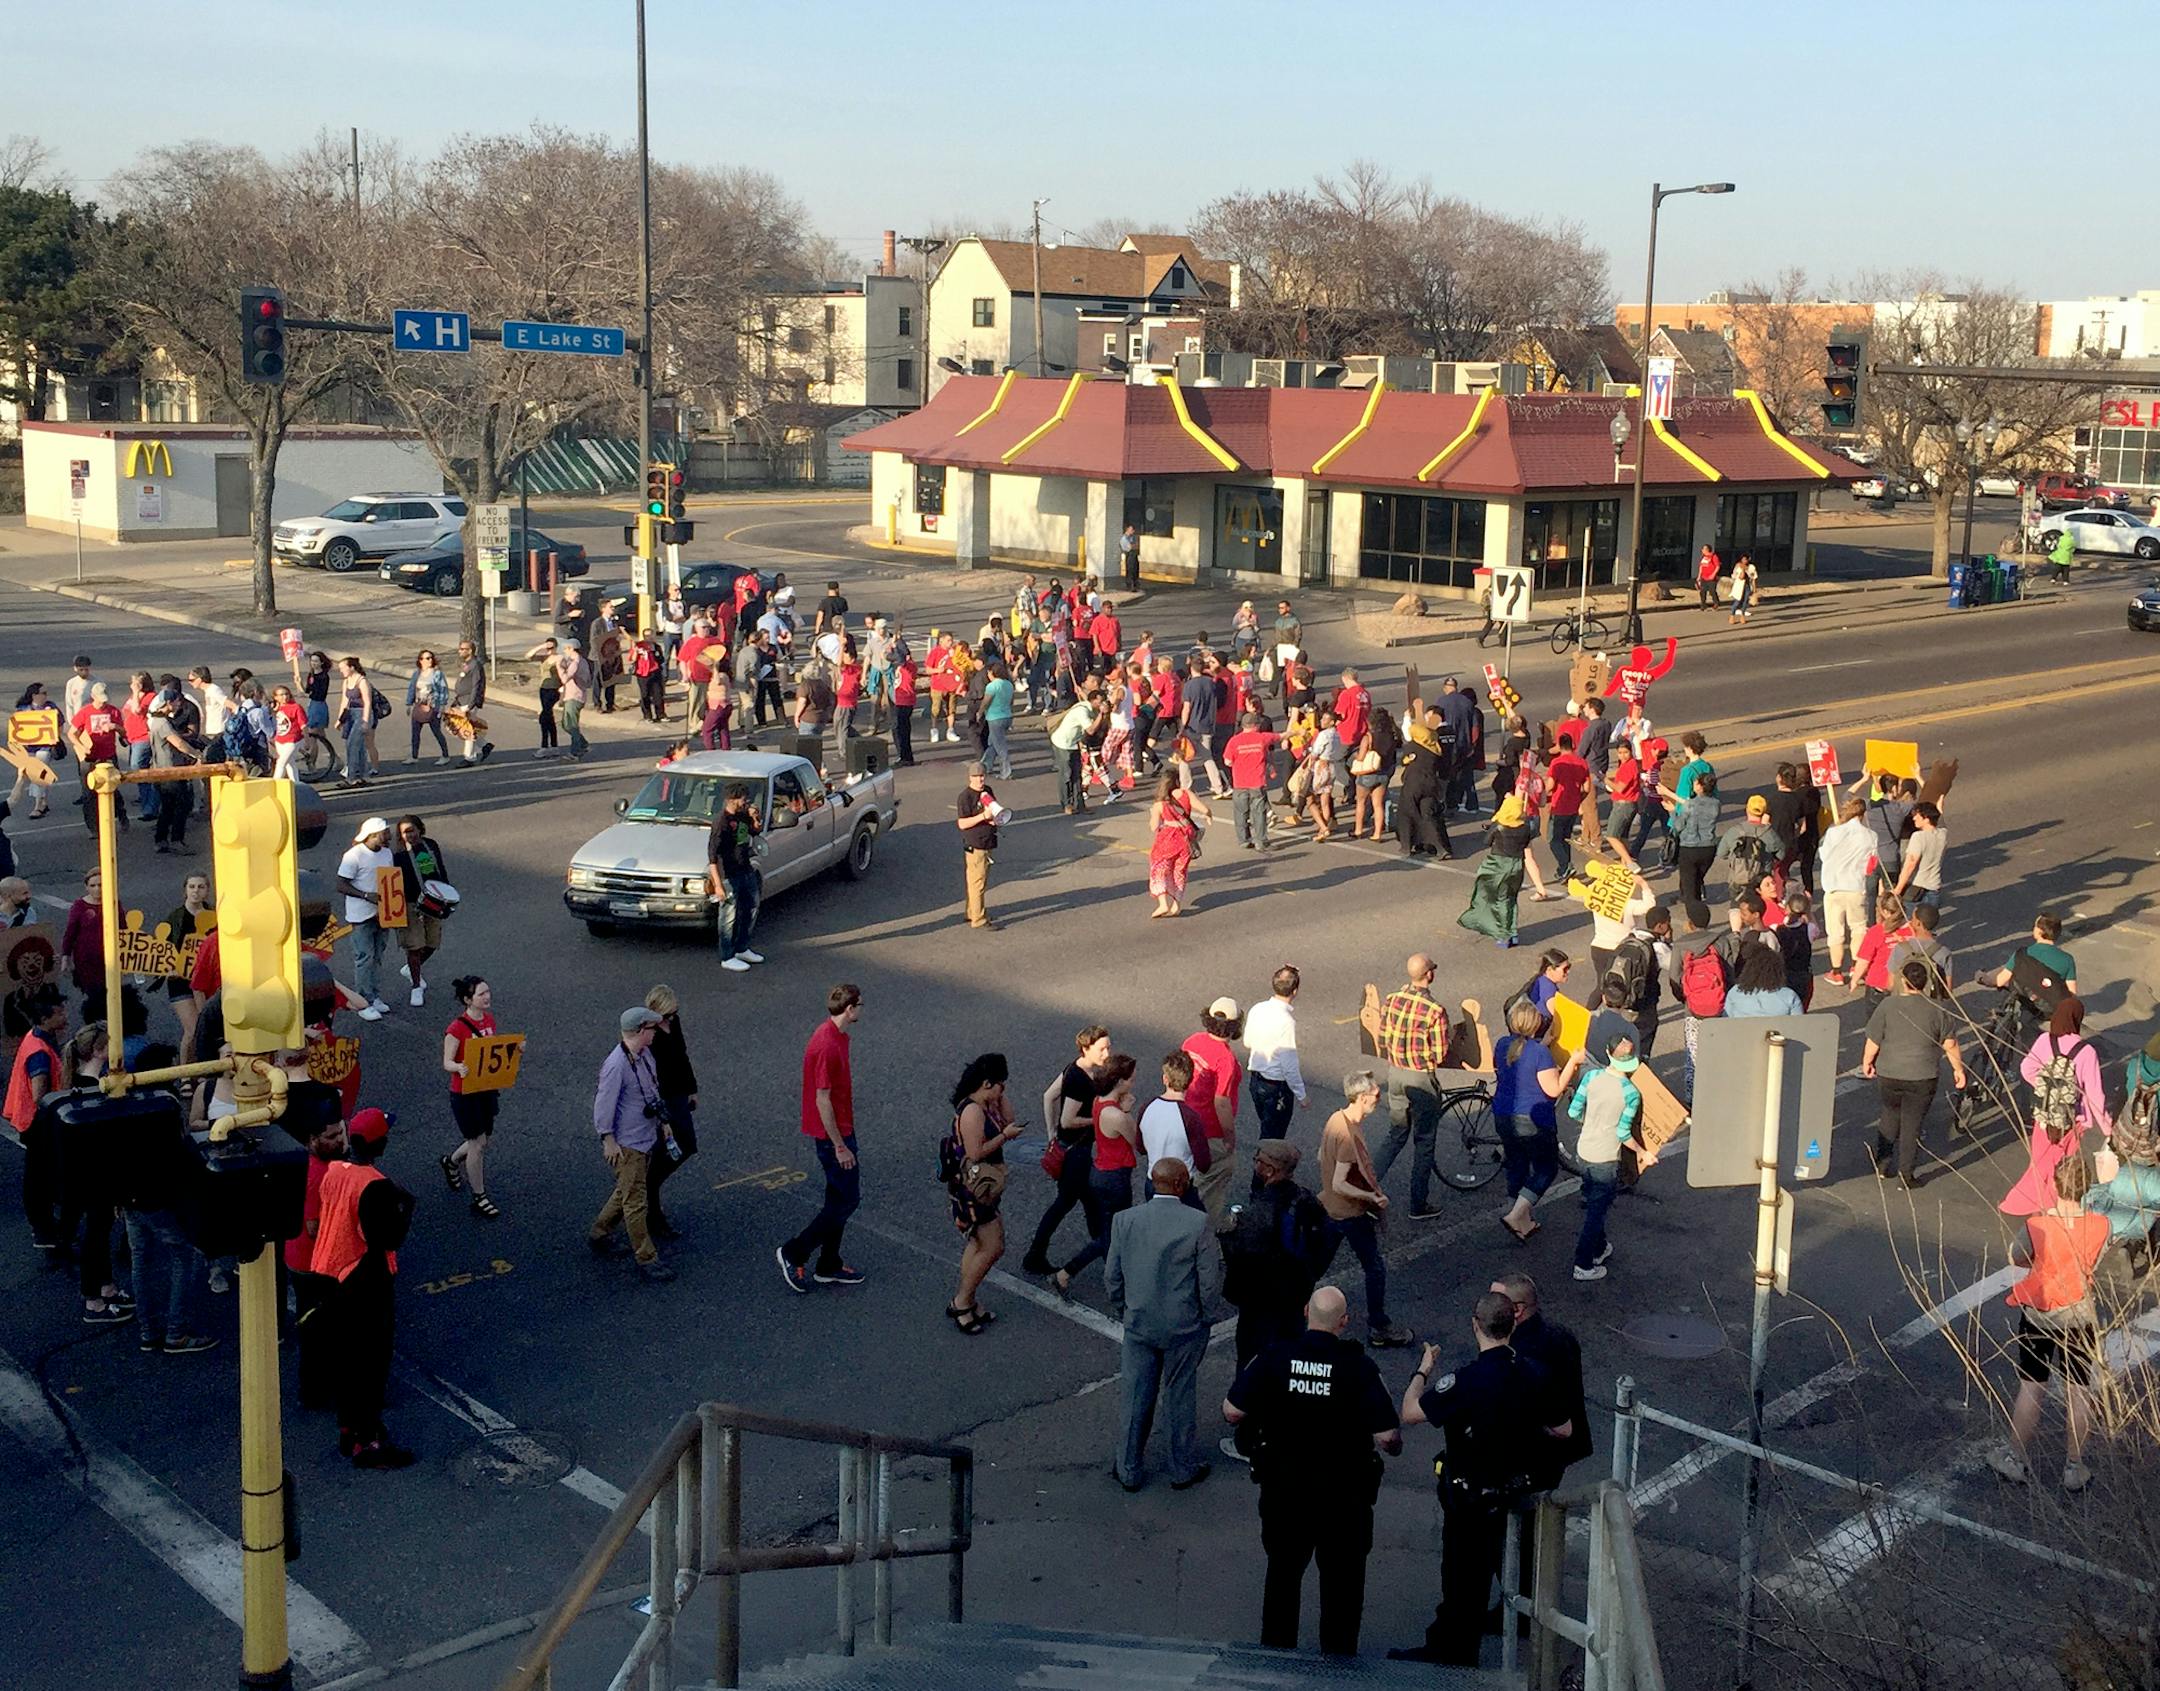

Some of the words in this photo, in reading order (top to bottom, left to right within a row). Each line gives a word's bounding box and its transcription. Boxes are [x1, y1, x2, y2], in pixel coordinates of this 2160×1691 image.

[435, 317, 460, 346] H
[518, 329, 528, 344] E
[539, 330, 582, 347] Lake
[591, 334, 611, 349] St
[2100, 400, 2145, 426] CSL
[486, 507, 498, 516] NO
[477, 517, 509, 526] ACCESS
[487, 526, 498, 535] TO
[477, 535, 508, 545] FREEWAY
[1588, 664, 1599, 679] LG
[1621, 669, 1652, 681] people
[10, 714, 56, 743] 15
[381, 870, 405, 921] 15
[1588, 885, 1609, 913] $15
[1602, 865, 1622, 888] FOR
[1604, 867, 1634, 922] FAMILIES
[150, 942, 173, 955] FOR
[119, 952, 177, 974] AMILIES
[1290, 1360, 1332, 1377] TRANSIT
[1289, 1379, 1331, 1396] POLICE
